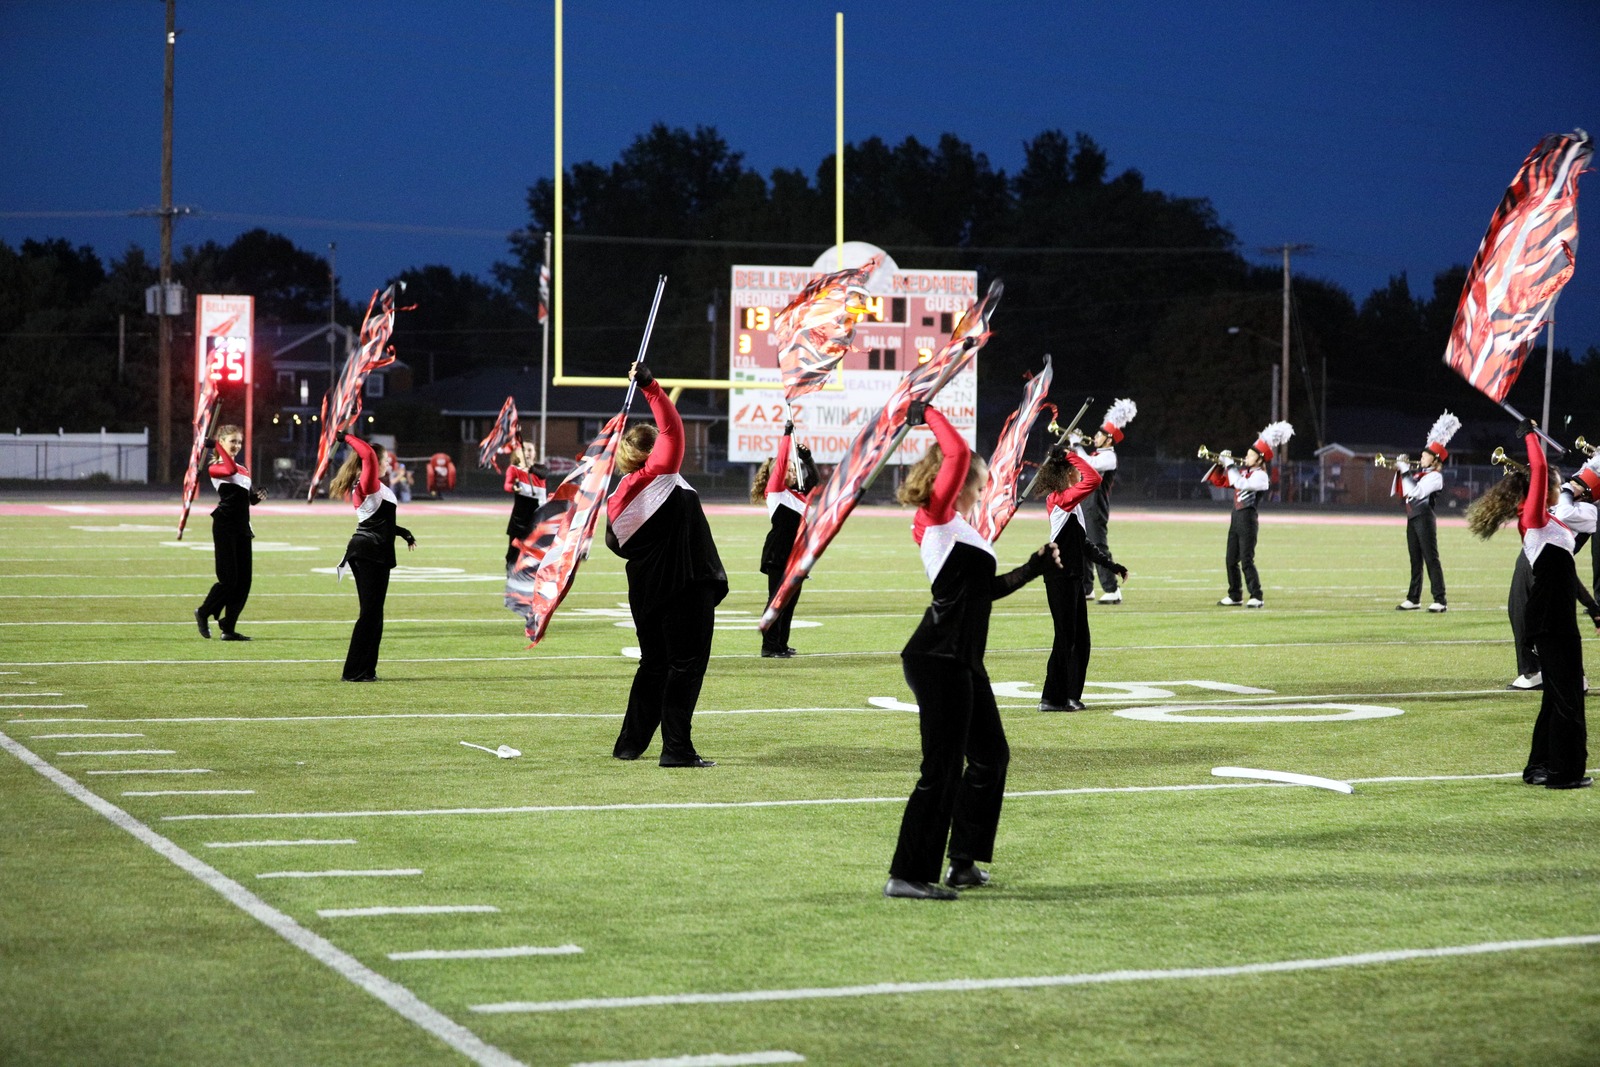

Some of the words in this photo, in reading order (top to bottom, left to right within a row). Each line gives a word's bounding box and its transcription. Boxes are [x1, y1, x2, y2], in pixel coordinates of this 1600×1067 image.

[735, 269, 823, 290] BELLEVU
[891, 273, 976, 294] REDMEN
[735, 292, 790, 307] REDMEN
[745, 305, 771, 331] 13
[738, 333, 752, 354] 3
[863, 336, 886, 349] BALL
[887, 337, 902, 349] ON
[914, 336, 936, 350] QTR
[816, 406, 850, 425] TWIN
